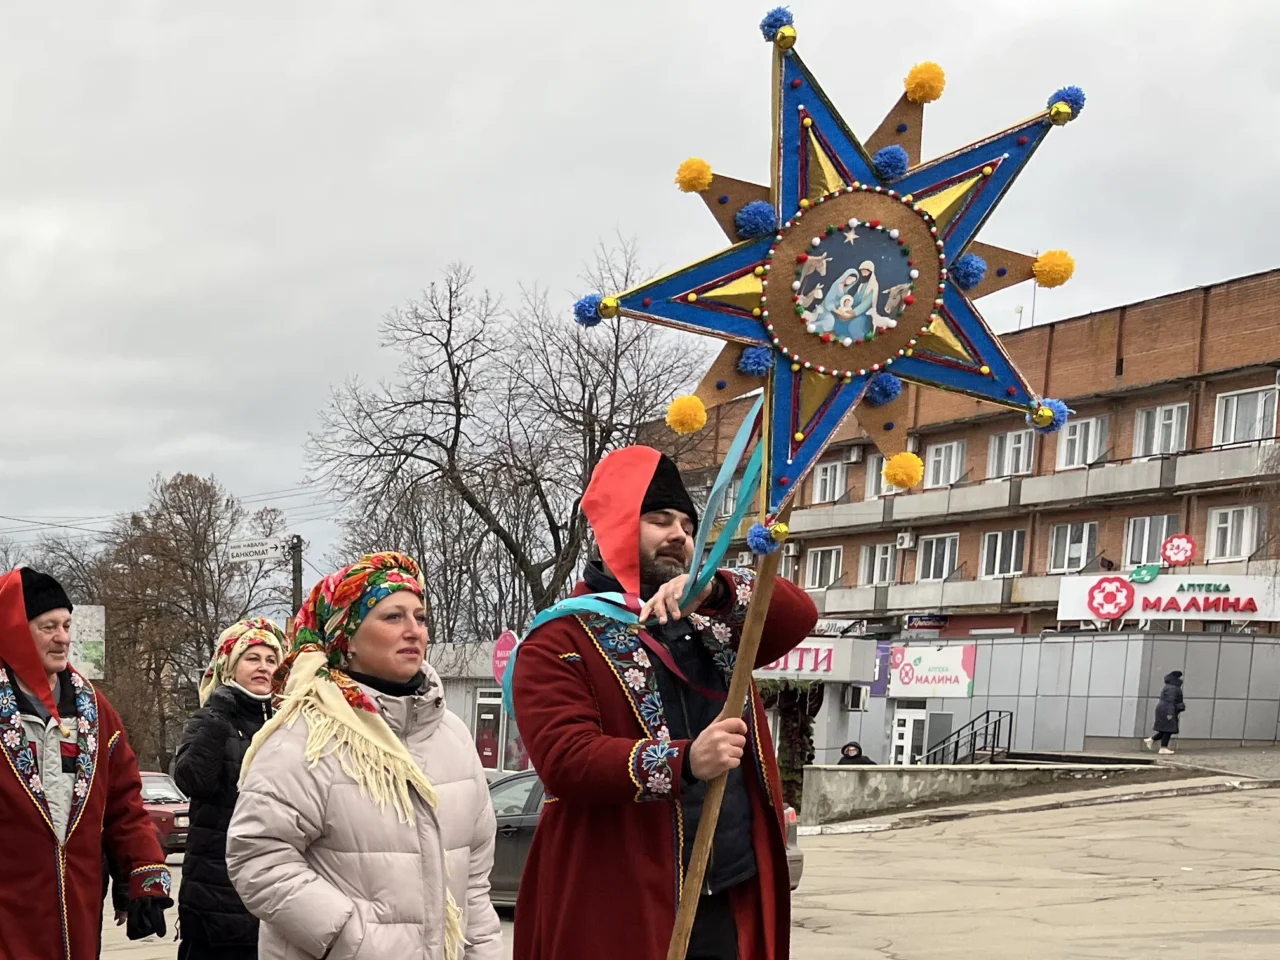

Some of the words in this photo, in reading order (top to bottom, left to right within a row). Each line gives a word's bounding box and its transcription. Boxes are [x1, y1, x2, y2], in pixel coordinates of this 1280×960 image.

[231, 549, 269, 559] БАНКОМАТ
[1169, 544, 1189, 556] 24/7
[1176, 583, 1231, 593] АПТЕКА
[1141, 596, 1259, 612] МАЛИНА
[915, 675, 960, 685] МАЛИНА
